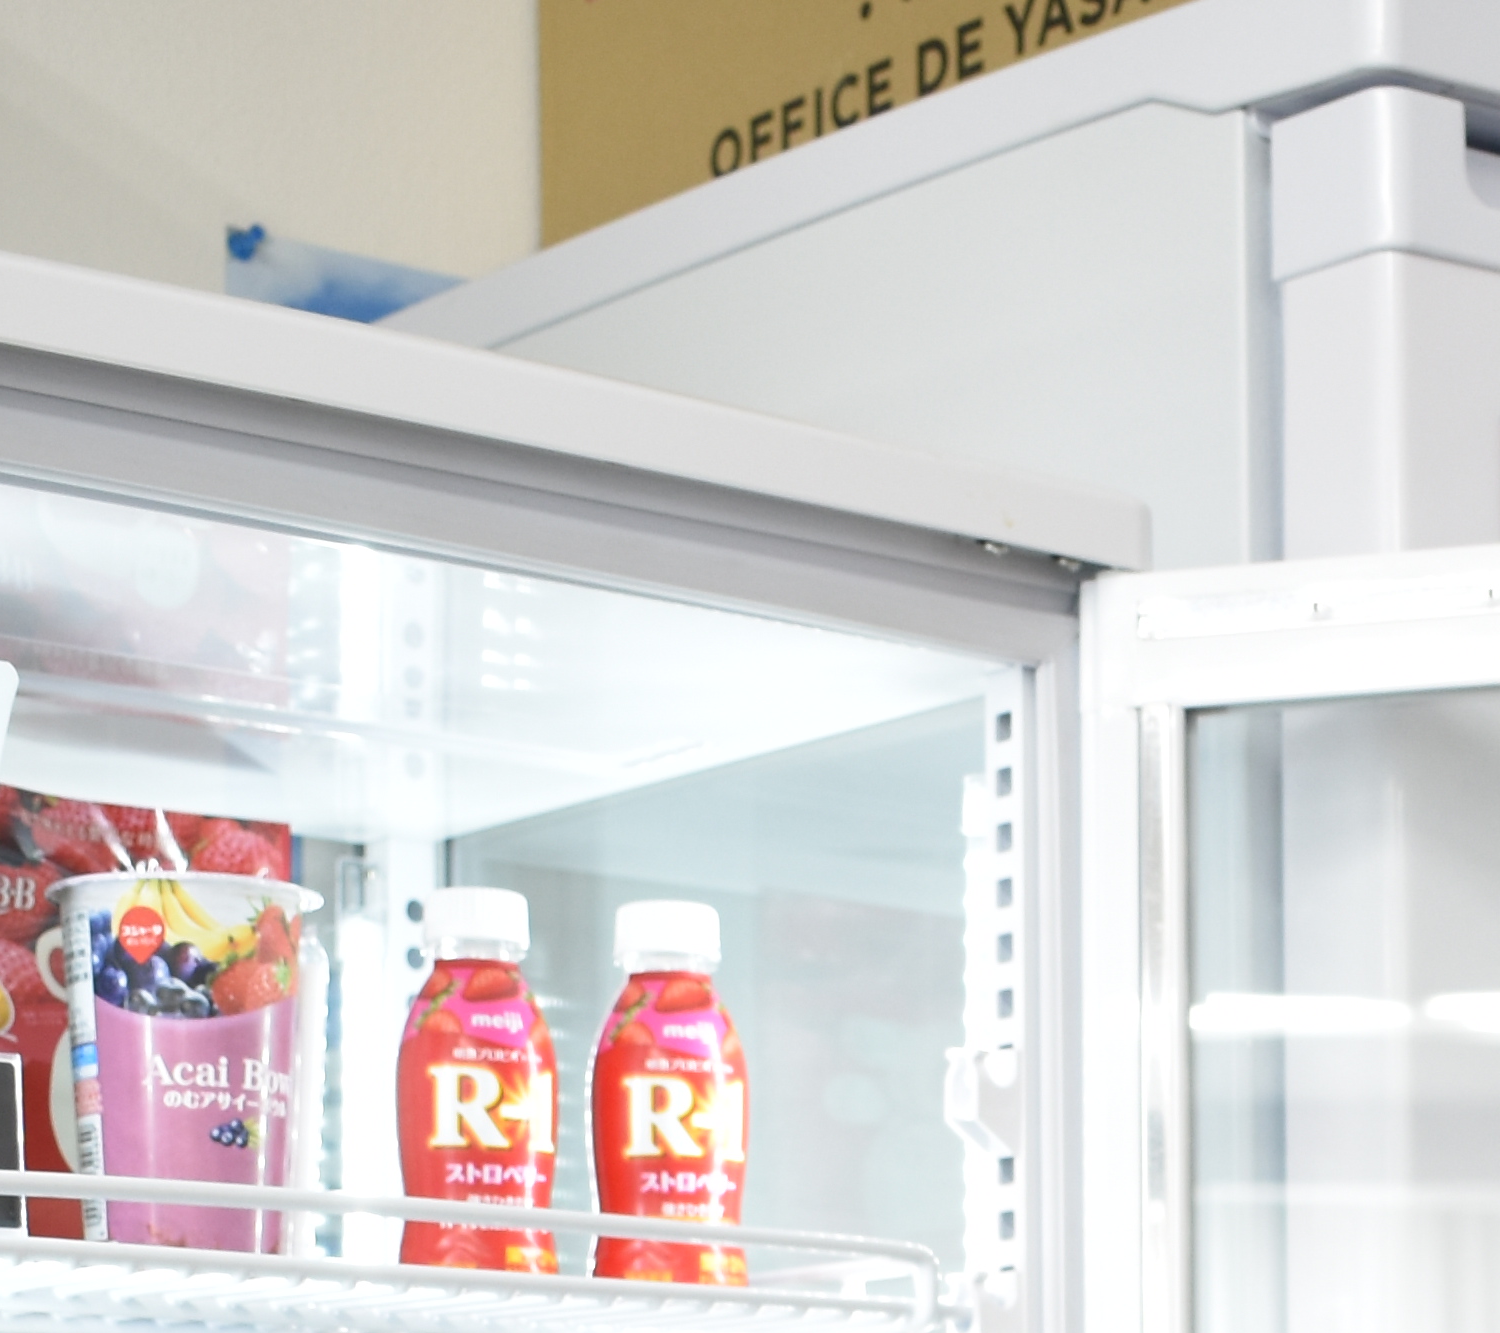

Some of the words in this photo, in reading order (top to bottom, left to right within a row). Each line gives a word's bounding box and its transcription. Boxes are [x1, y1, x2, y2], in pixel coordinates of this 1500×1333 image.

[710, 58, 894, 178] OFFICE
[916, 18, 984, 98] DE
[470, 1011, 524, 1036] meiji
[662, 1022, 716, 1048] meiji
[143, 1053, 229, 1091] Acai
[426, 1062, 556, 1156] R-1
[622, 1074, 746, 1165] R-1
